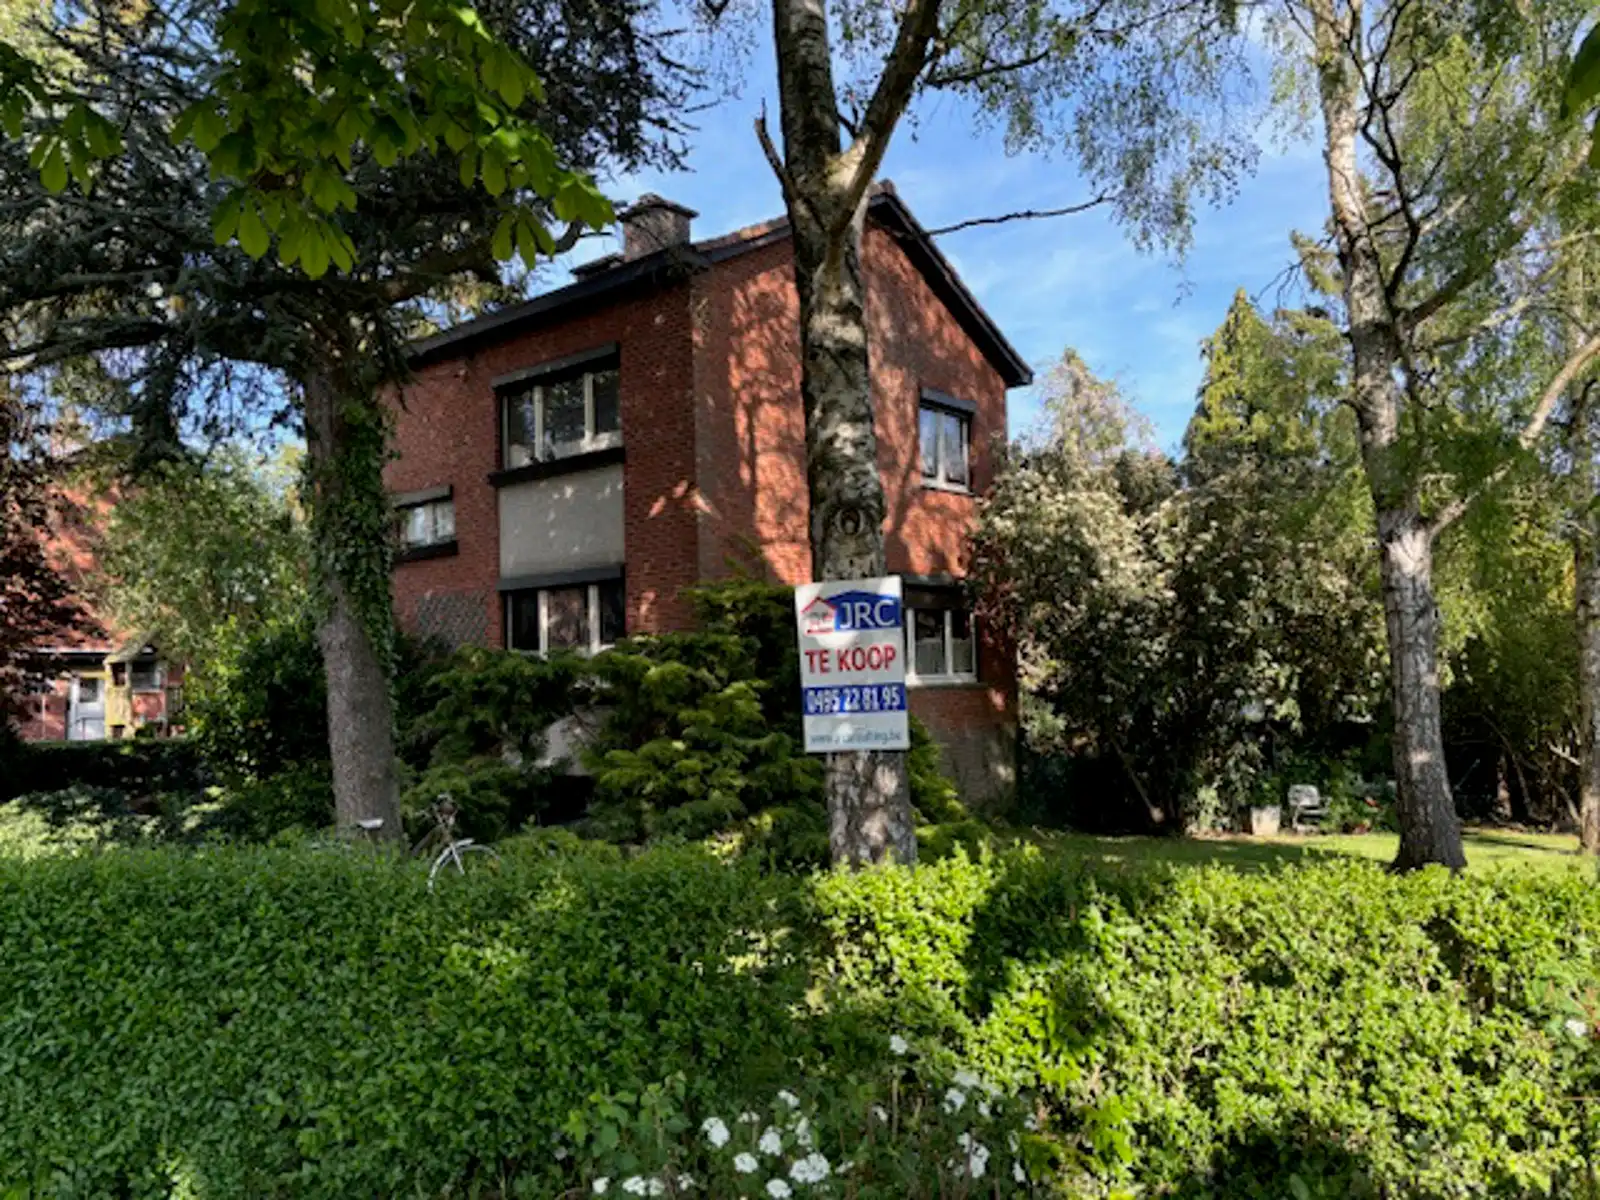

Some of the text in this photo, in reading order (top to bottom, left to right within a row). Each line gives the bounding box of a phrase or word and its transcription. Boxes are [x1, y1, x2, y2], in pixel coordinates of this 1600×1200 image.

[840, 600, 895, 628] JRC
[805, 645, 897, 673] TE KOOP
[843, 688, 860, 711] 22
[862, 687, 880, 710] 81
[882, 686, 900, 709] 95
